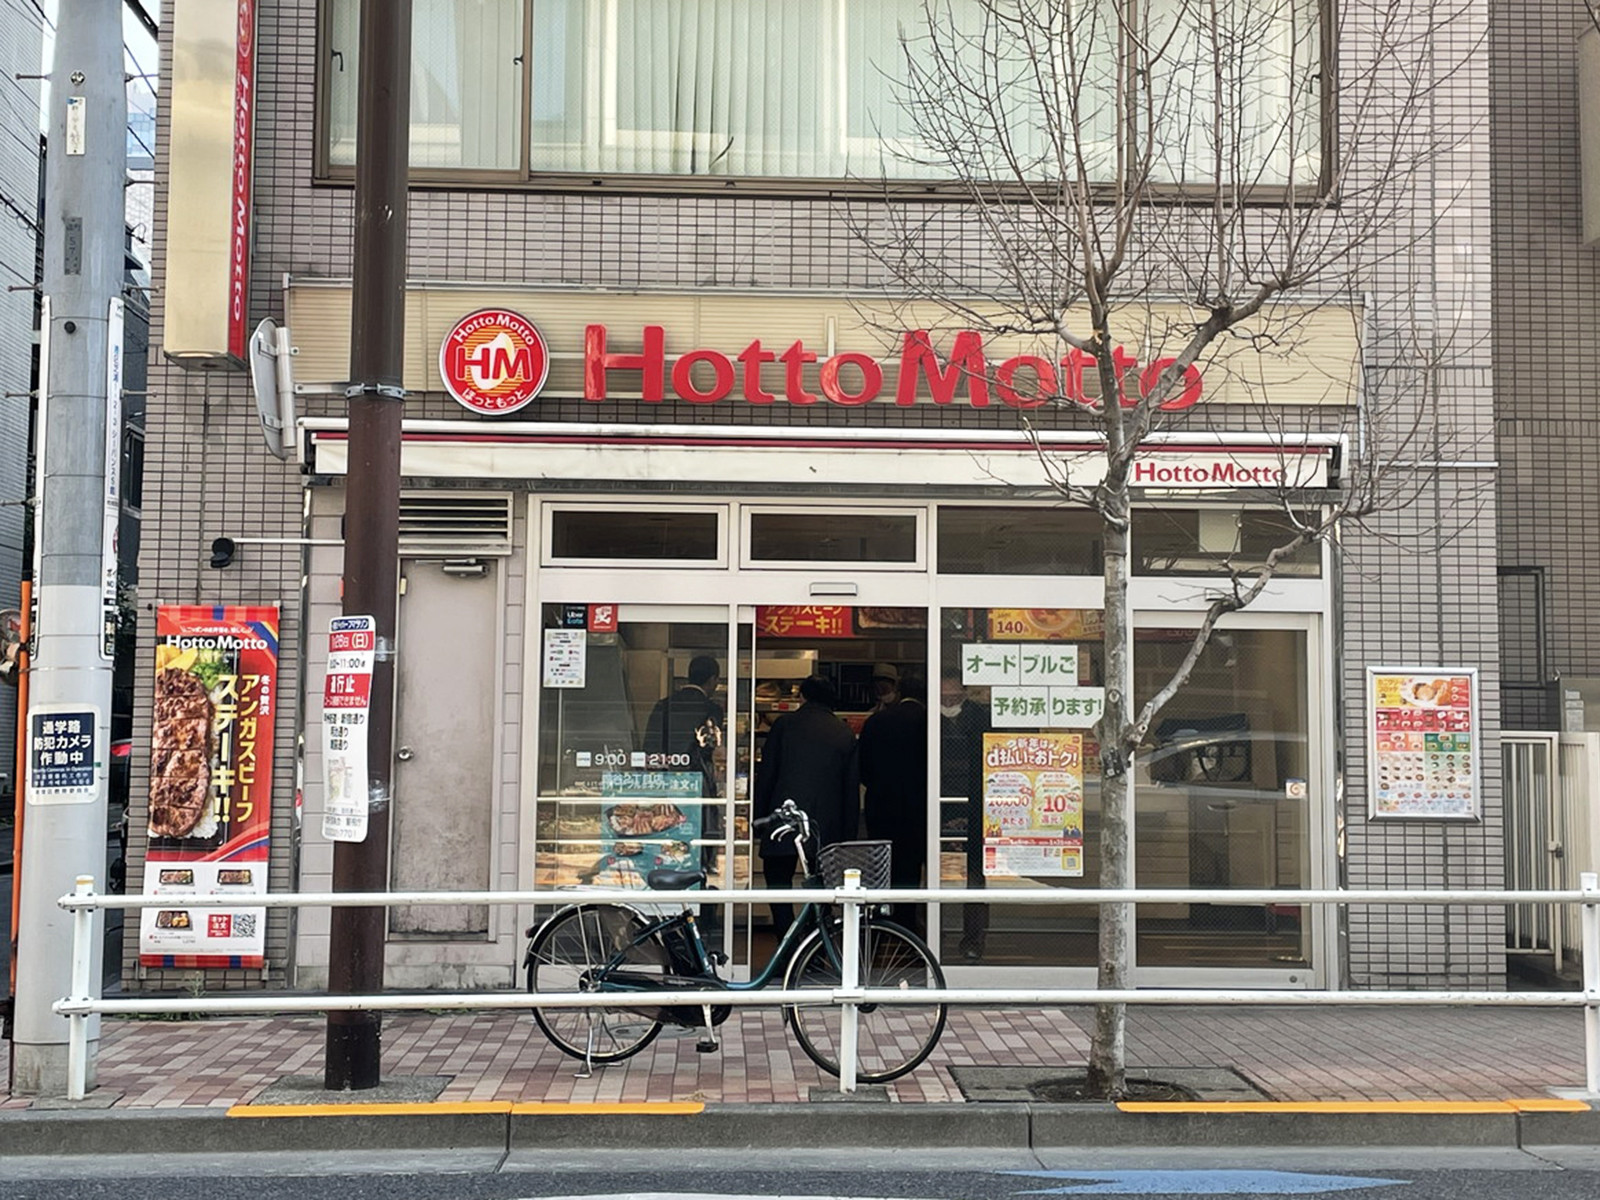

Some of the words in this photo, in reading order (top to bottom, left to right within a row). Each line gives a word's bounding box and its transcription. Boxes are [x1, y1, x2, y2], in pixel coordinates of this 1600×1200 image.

[453, 314, 535, 345] HottoMotto
[455, 346, 533, 382] HM
[1135, 462, 1288, 482] HottoMotto
[166, 634, 268, 650] HottoMotto
[966, 655, 1075, 675] オードブルご
[993, 697, 1102, 716] 予約承ります!
[42, 720, 80, 734] 通学路
[33, 735, 92, 751] 防犯カメラ
[211, 674, 239, 823] ステーキ!!
[236, 674, 260, 822] アンガスビーフ
[40, 751, 84, 766] 作動中
[594, 752, 627, 766] 9:00
[649, 752, 691, 766] 21:00
[987, 749, 1078, 768] d払いでおトク!
